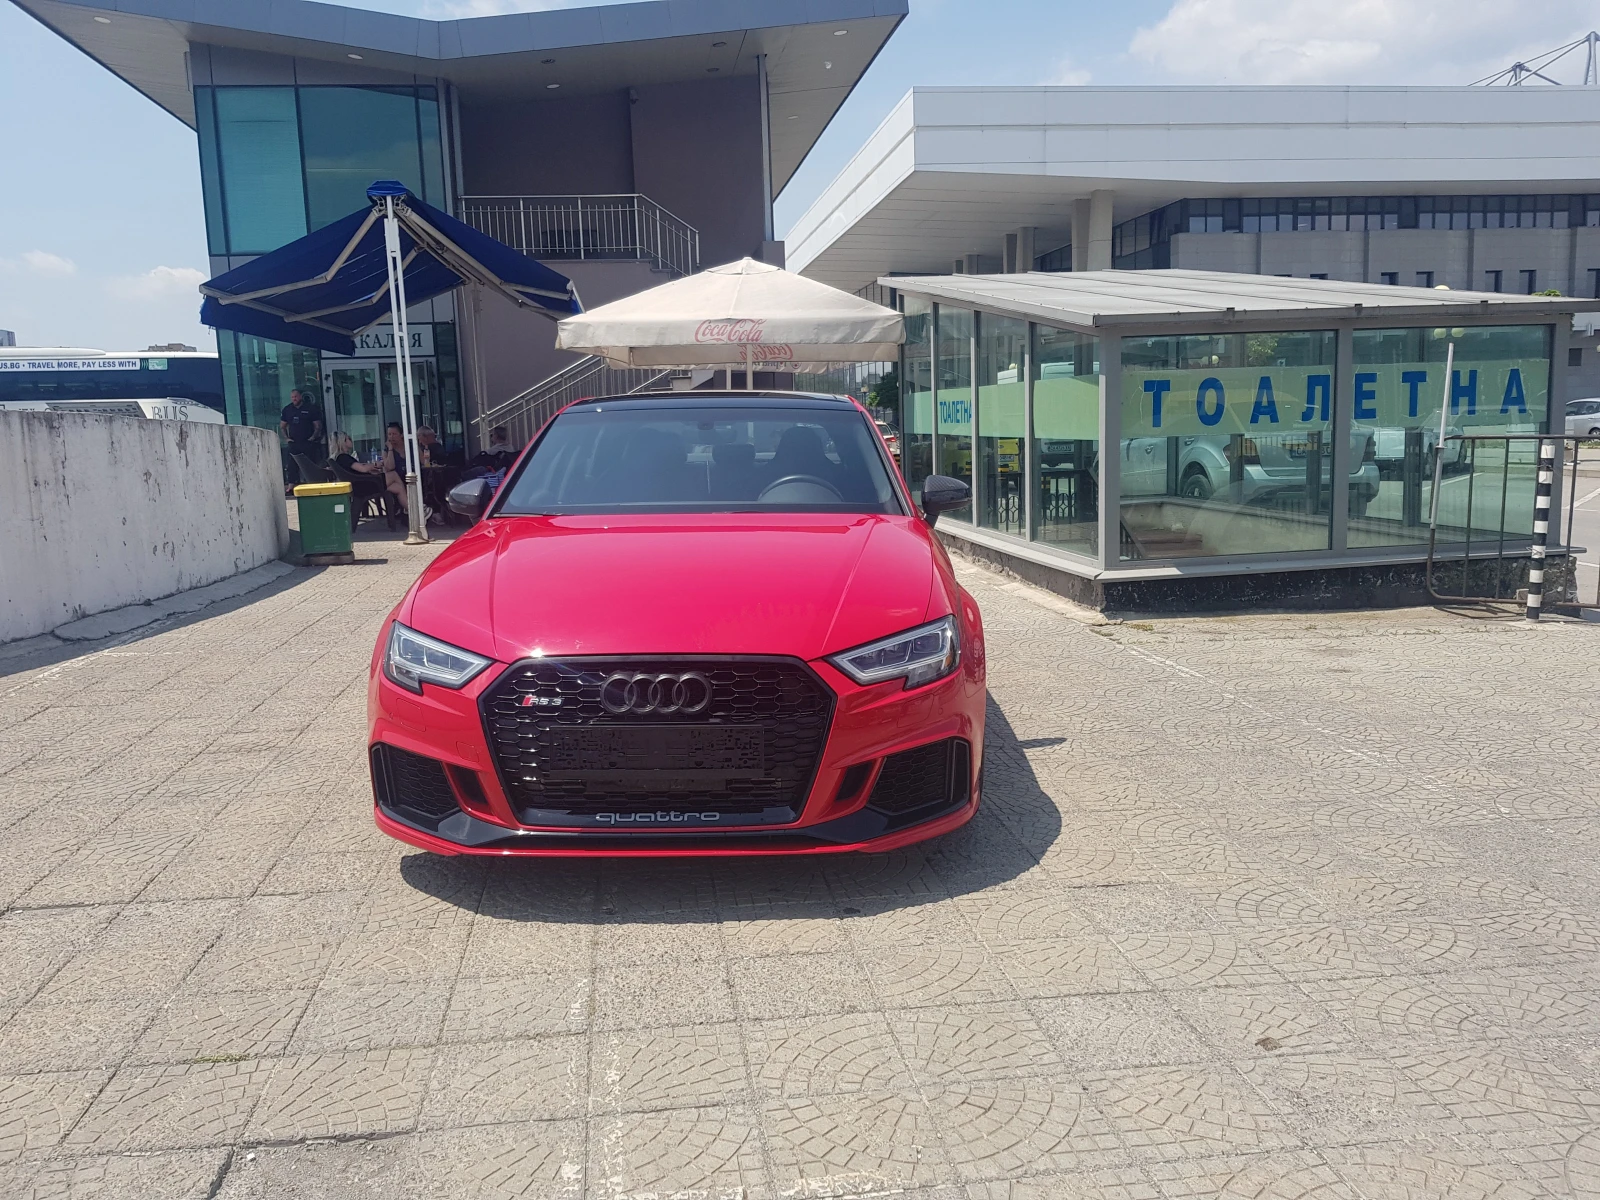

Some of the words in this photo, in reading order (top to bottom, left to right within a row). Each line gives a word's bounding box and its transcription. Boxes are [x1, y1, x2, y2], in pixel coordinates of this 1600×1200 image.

[27, 361, 55, 369] TRAVEL
[58, 361, 80, 369] MORE,
[82, 361, 96, 369] PAY
[1143, 368, 1528, 428] ТОАЛЕТНА
[596, 810, 720, 825] quattro
